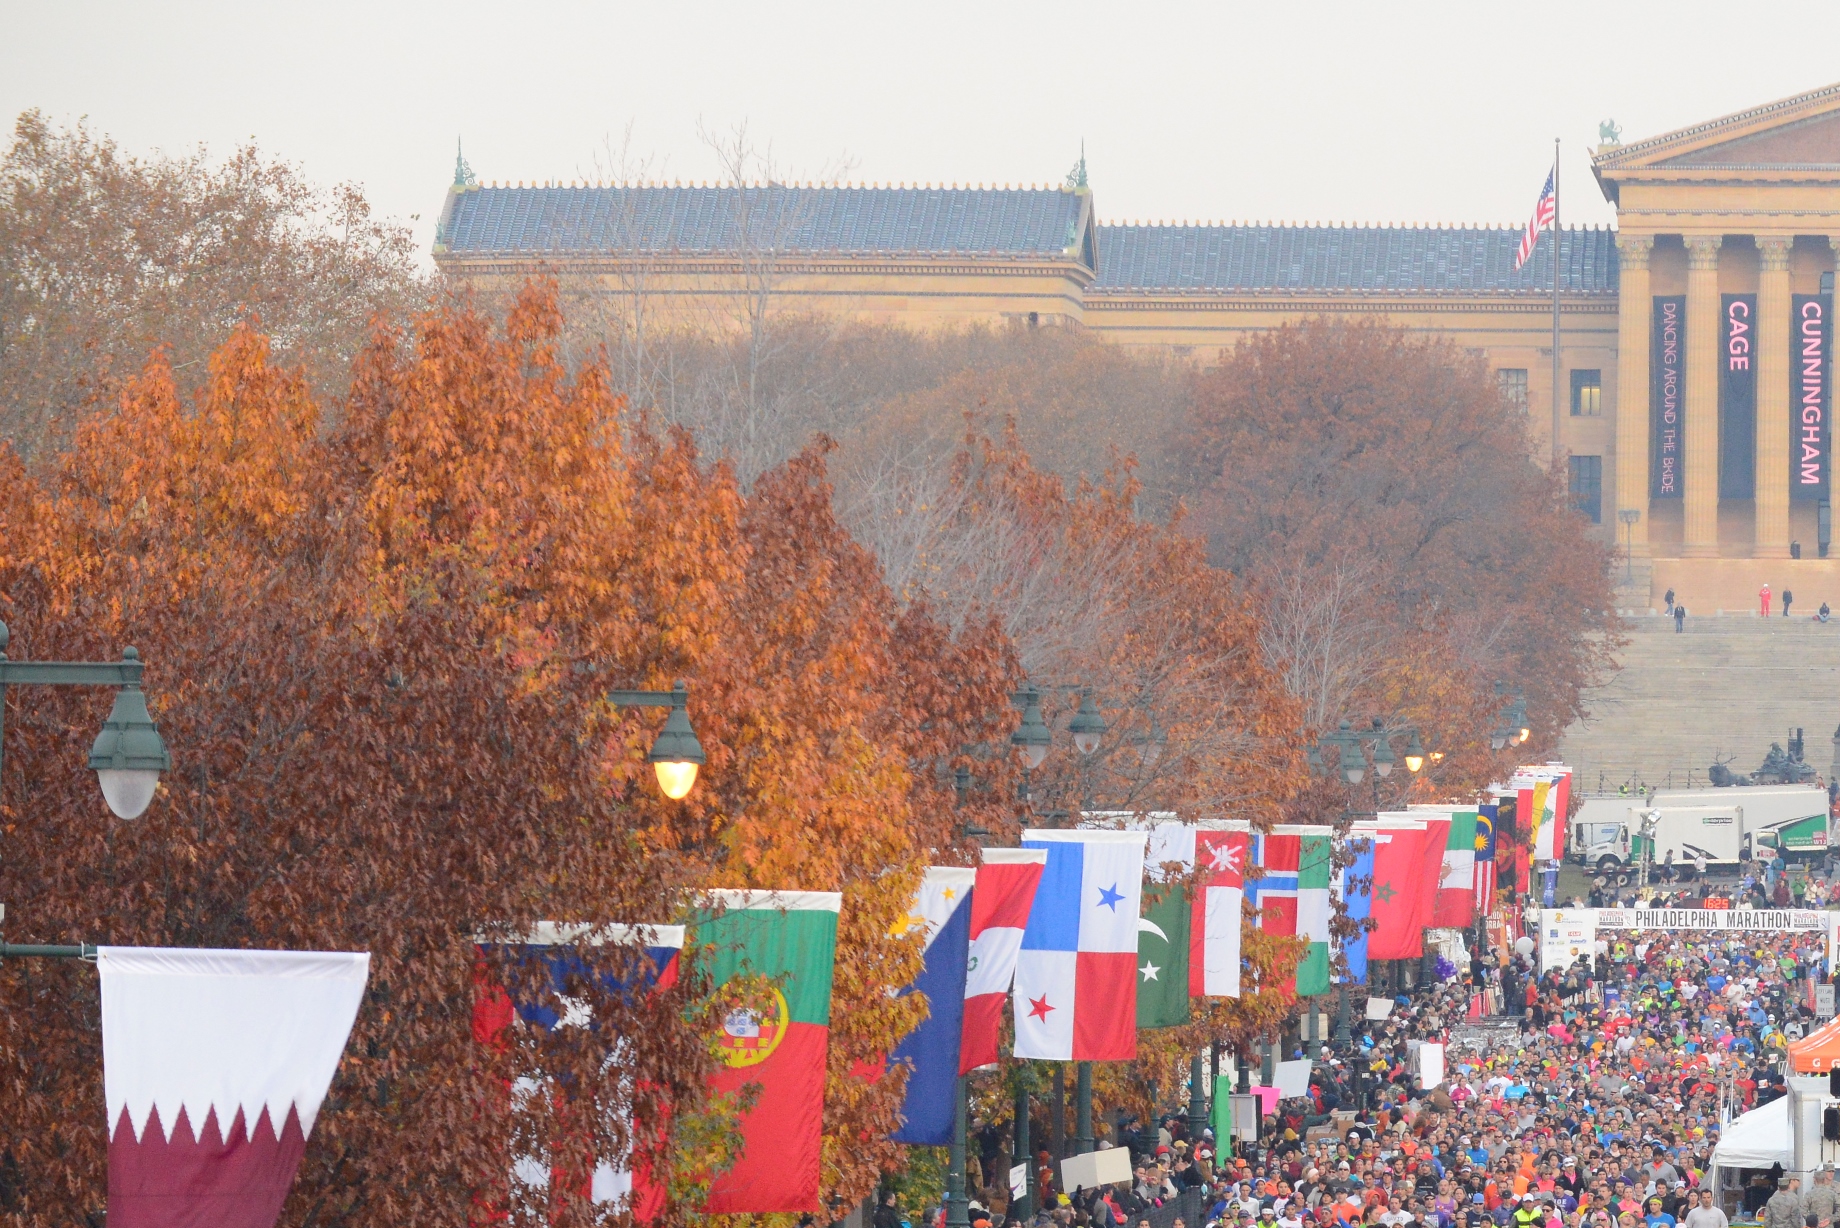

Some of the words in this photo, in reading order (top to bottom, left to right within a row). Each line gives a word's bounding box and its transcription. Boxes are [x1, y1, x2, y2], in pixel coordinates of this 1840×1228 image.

[1663, 303, 1676, 364] DANCING
[1728, 301, 1749, 370] CAGE
[1664, 368, 1676, 424] AROUND
[1801, 302, 1822, 484] CUNNINGHAM
[1664, 428, 1674, 453] THE
[1661, 458, 1675, 494] BRIDE
[1636, 910, 1717, 928] PHILADELPHIA
[1727, 911, 1791, 929] MARATHON
